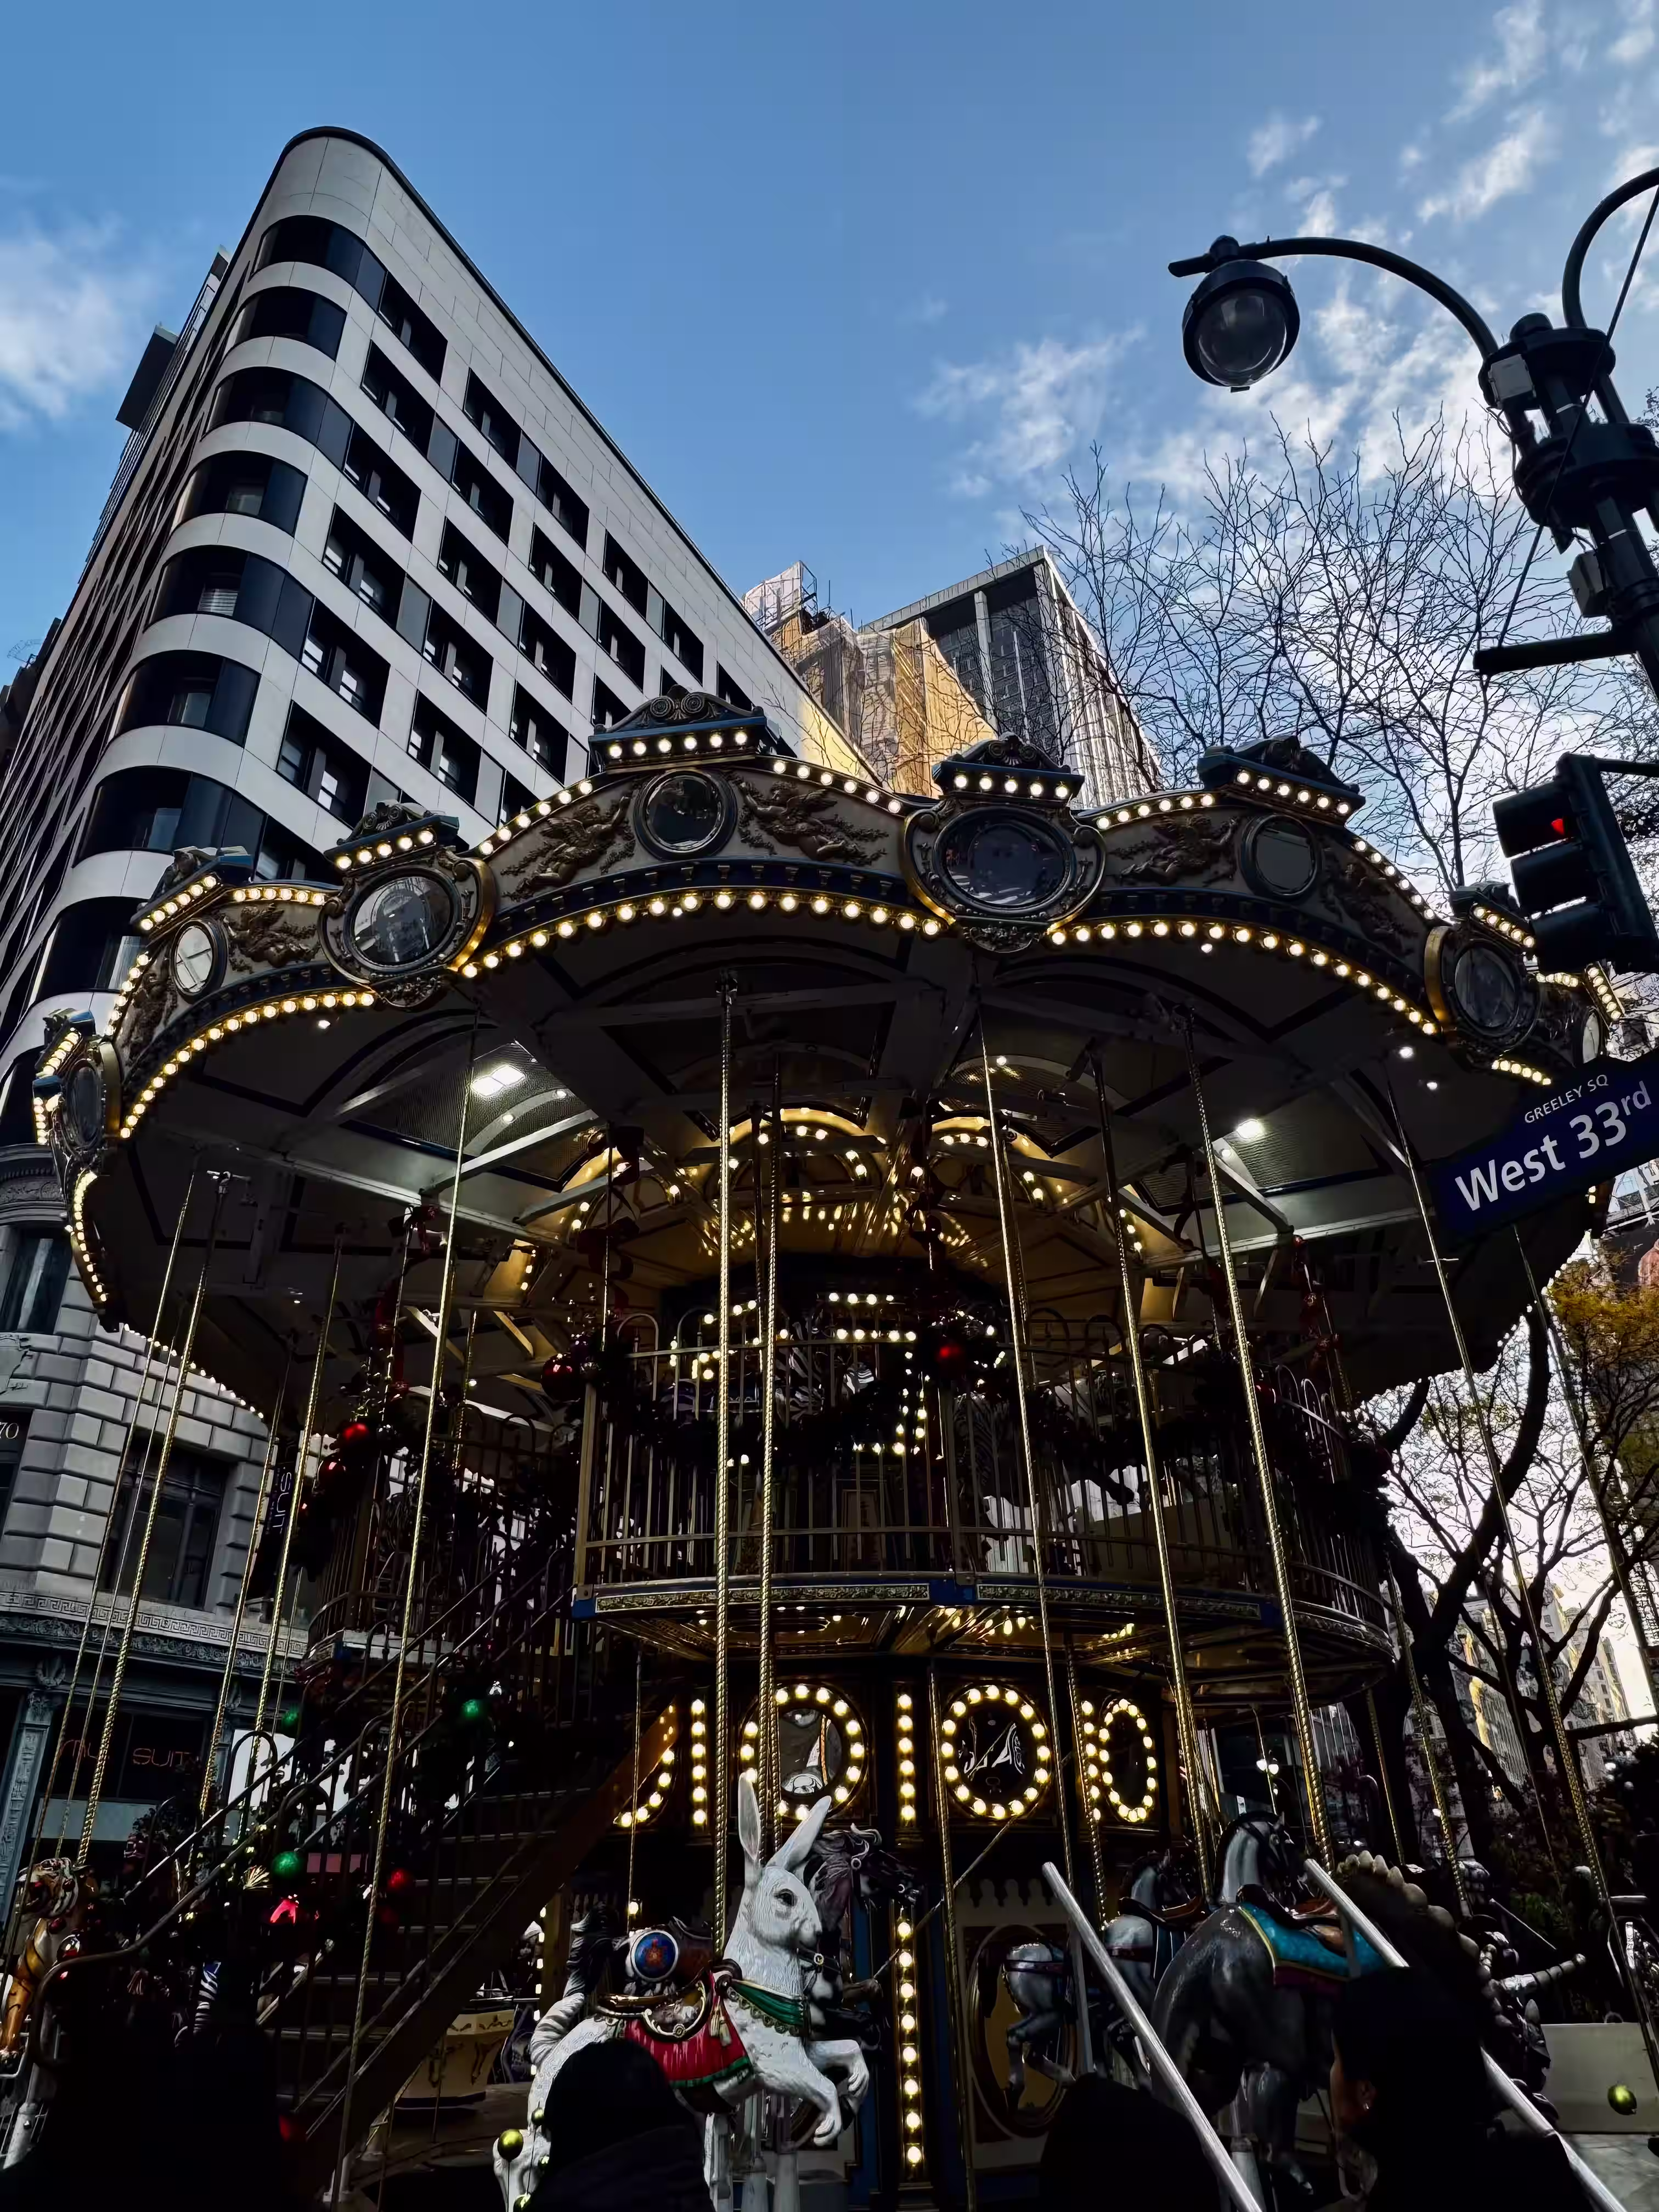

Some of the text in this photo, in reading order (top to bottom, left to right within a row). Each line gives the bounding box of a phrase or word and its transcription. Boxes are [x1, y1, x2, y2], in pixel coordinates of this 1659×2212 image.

[1524, 1074, 1609, 1123] GREELEY SQ
[1454, 1080, 1652, 1211] West 33rd
[132, 1747, 193, 1768] SUIT
